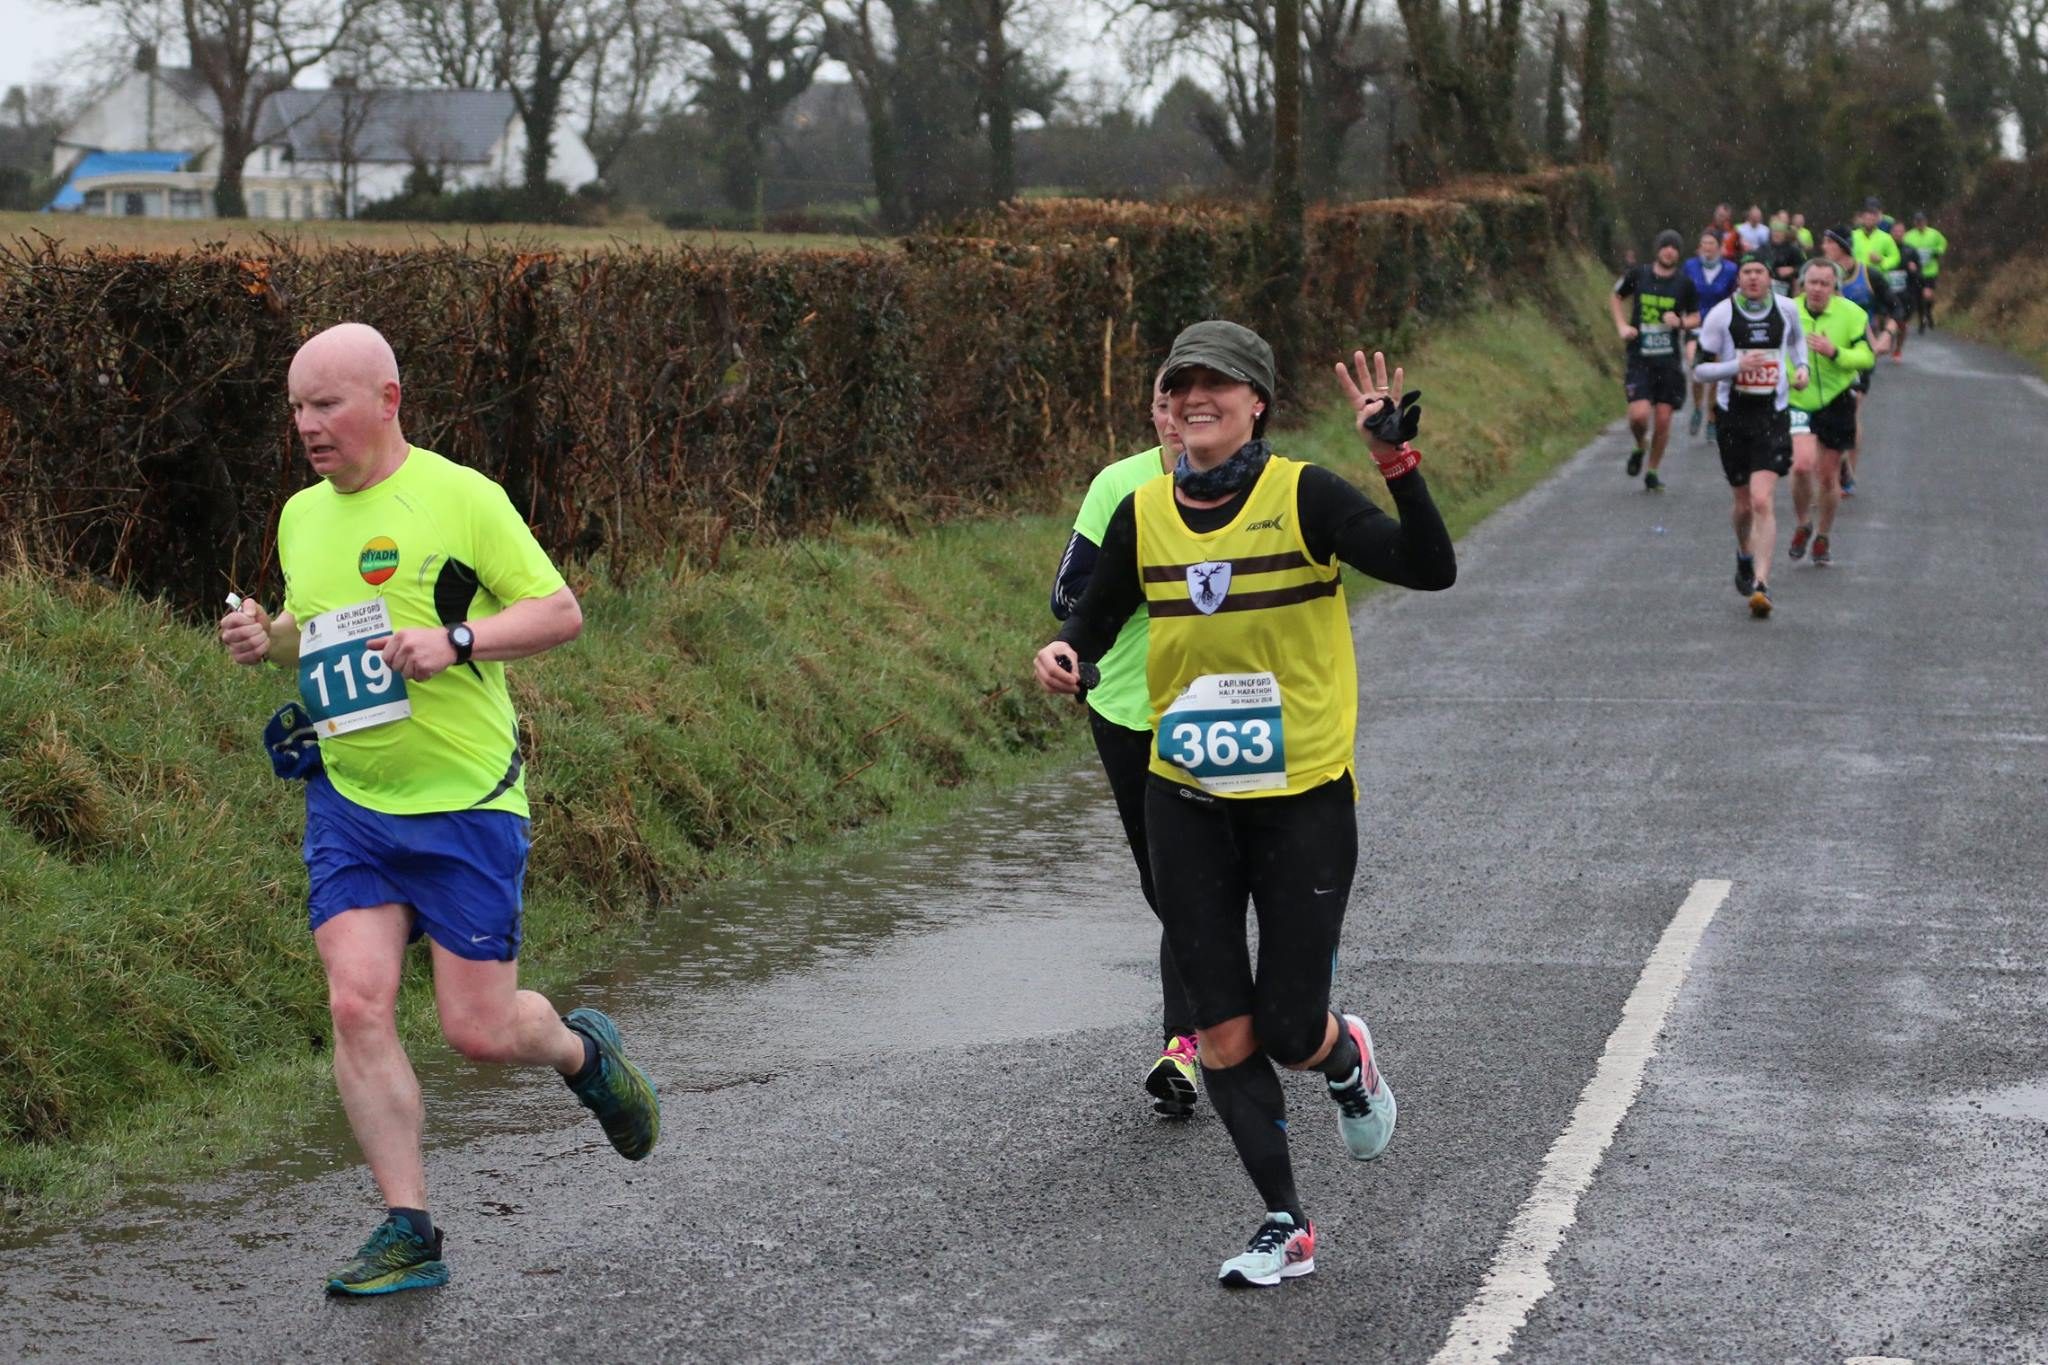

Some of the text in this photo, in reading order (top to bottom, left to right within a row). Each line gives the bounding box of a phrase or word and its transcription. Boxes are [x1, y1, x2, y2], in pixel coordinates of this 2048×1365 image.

[1737, 366, 1778, 384] 1032
[361, 549, 398, 562] RIYADH
[336, 604, 380, 622] CARLINGFORD
[337, 613, 383, 630] HALF MARATHON
[310, 649, 392, 707] 119
[1218, 677, 1271, 688] CARLINGFORD
[1237, 687, 1272, 695] MARATHON
[1172, 719, 1274, 768] 363
